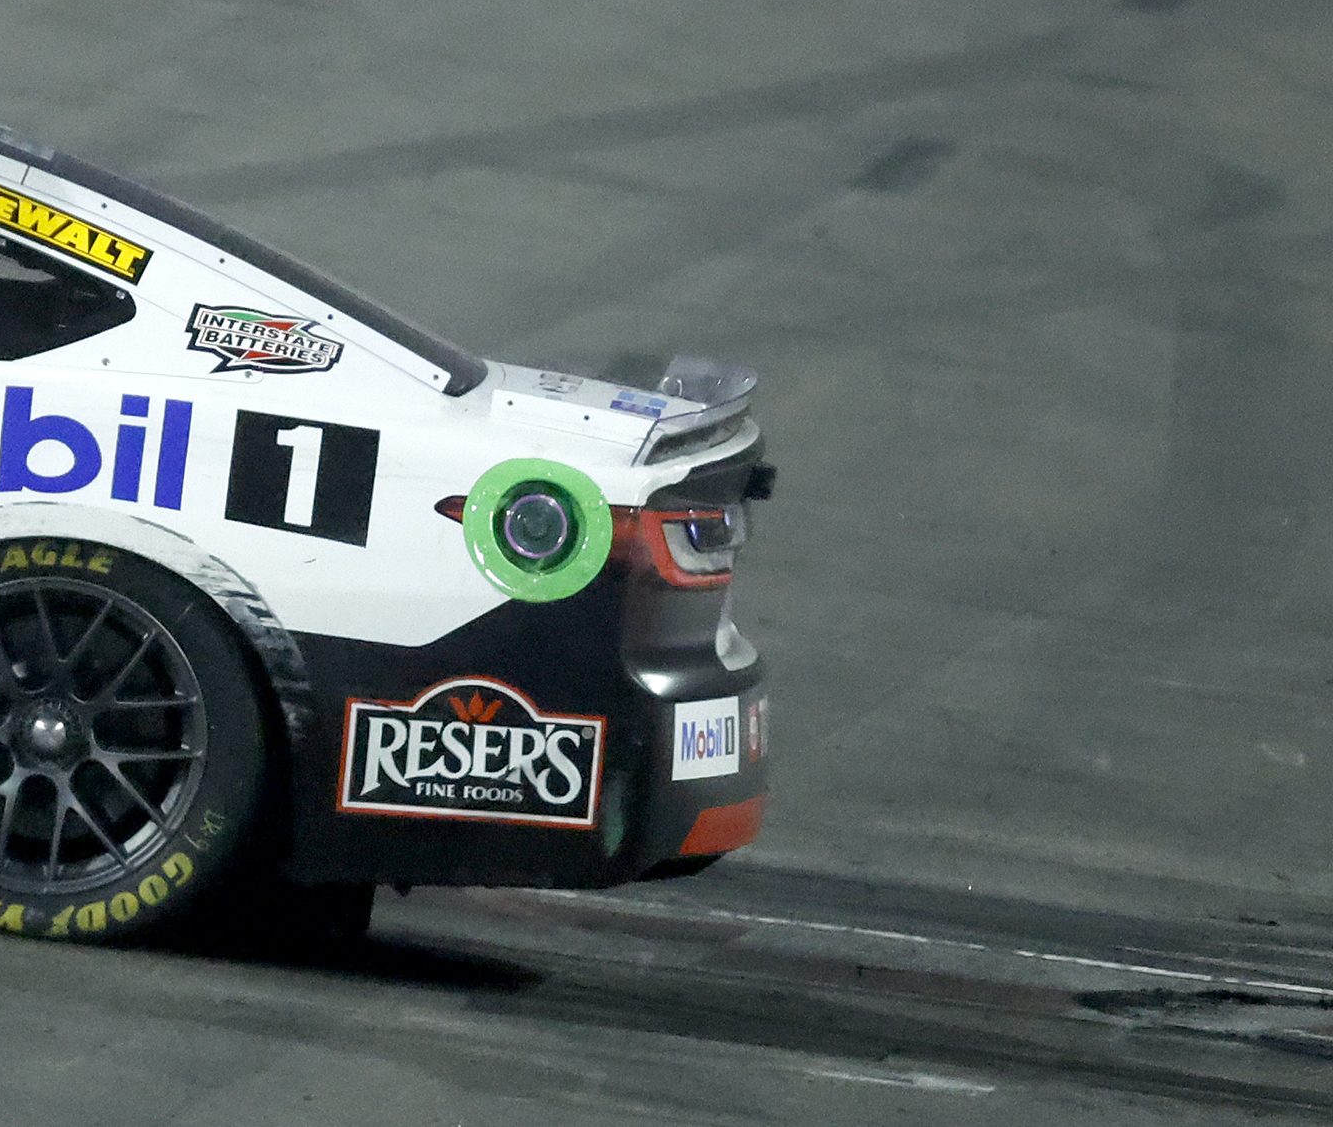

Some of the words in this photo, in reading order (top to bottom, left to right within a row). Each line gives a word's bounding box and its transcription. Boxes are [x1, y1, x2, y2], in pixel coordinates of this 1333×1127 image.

[201, 312, 331, 354] INTERSTATE
[204, 328, 327, 365] BATTERIES
[359, 716, 583, 805] RESER'S
[680, 717, 723, 762] Mobil
[415, 781, 456, 799] FINE
[462, 783, 524, 803] FOODS
